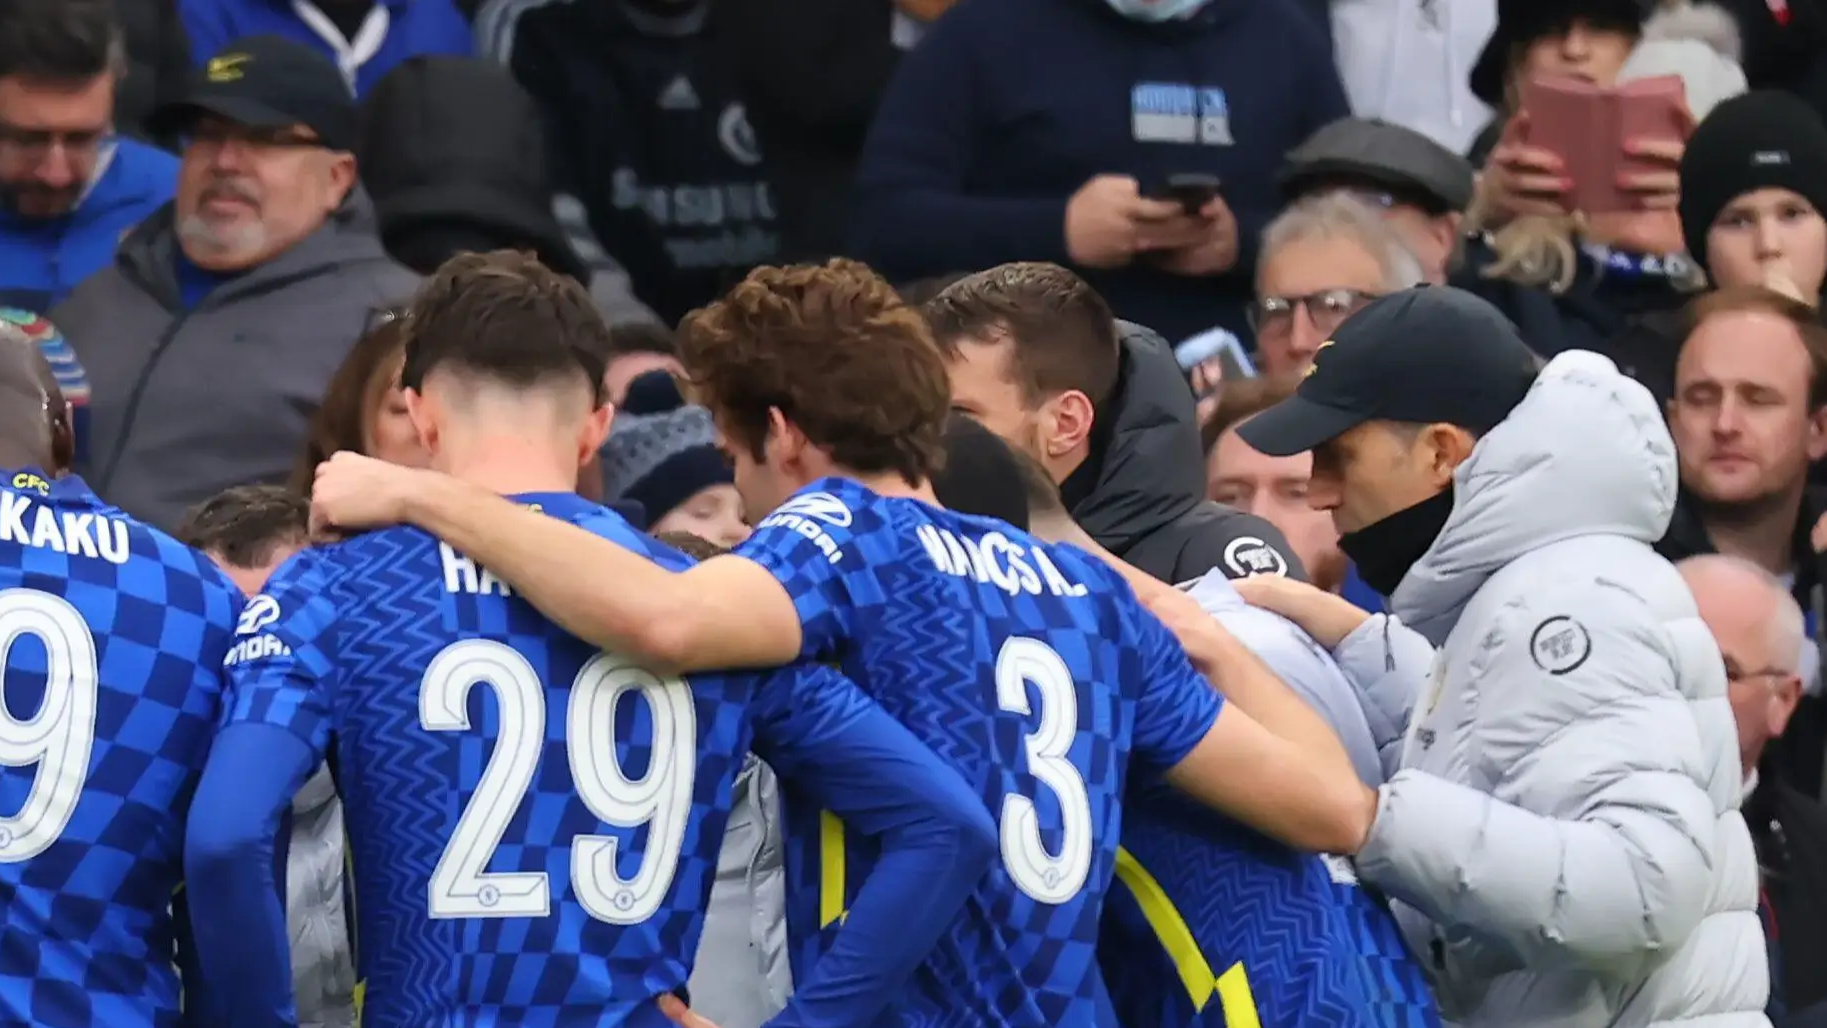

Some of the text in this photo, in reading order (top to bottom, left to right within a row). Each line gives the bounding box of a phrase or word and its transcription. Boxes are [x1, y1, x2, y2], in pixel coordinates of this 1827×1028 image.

[12, 473, 50, 497] CFC
[419, 638, 697, 925] 29
[995, 635, 1093, 904] 3
